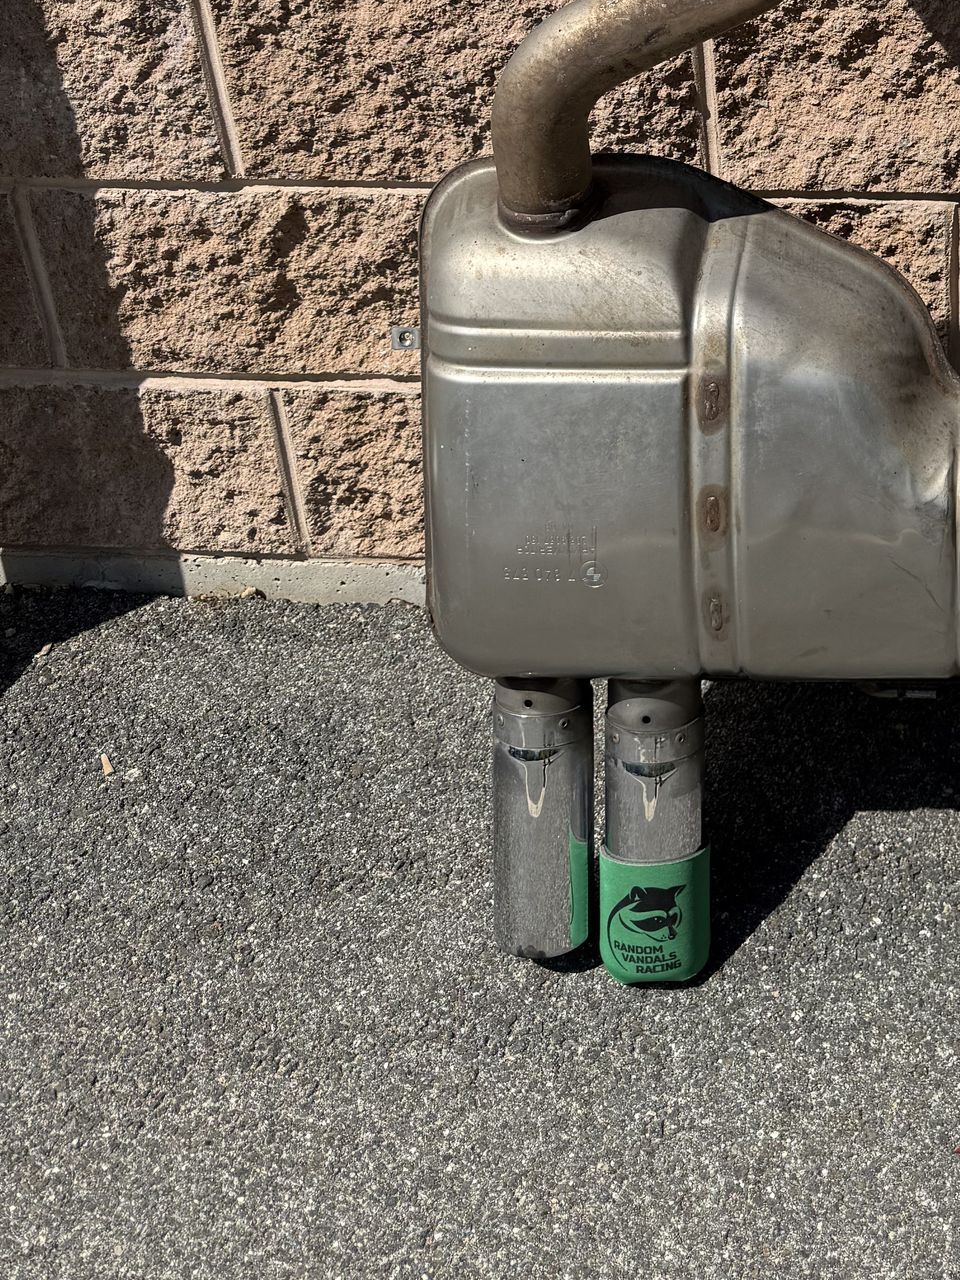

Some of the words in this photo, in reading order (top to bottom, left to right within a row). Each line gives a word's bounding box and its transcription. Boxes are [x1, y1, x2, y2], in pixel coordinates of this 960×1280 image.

[614, 940, 663, 955] RANDOM
[621, 951, 677, 964] VANDALS
[635, 960, 682, 974] RACING
